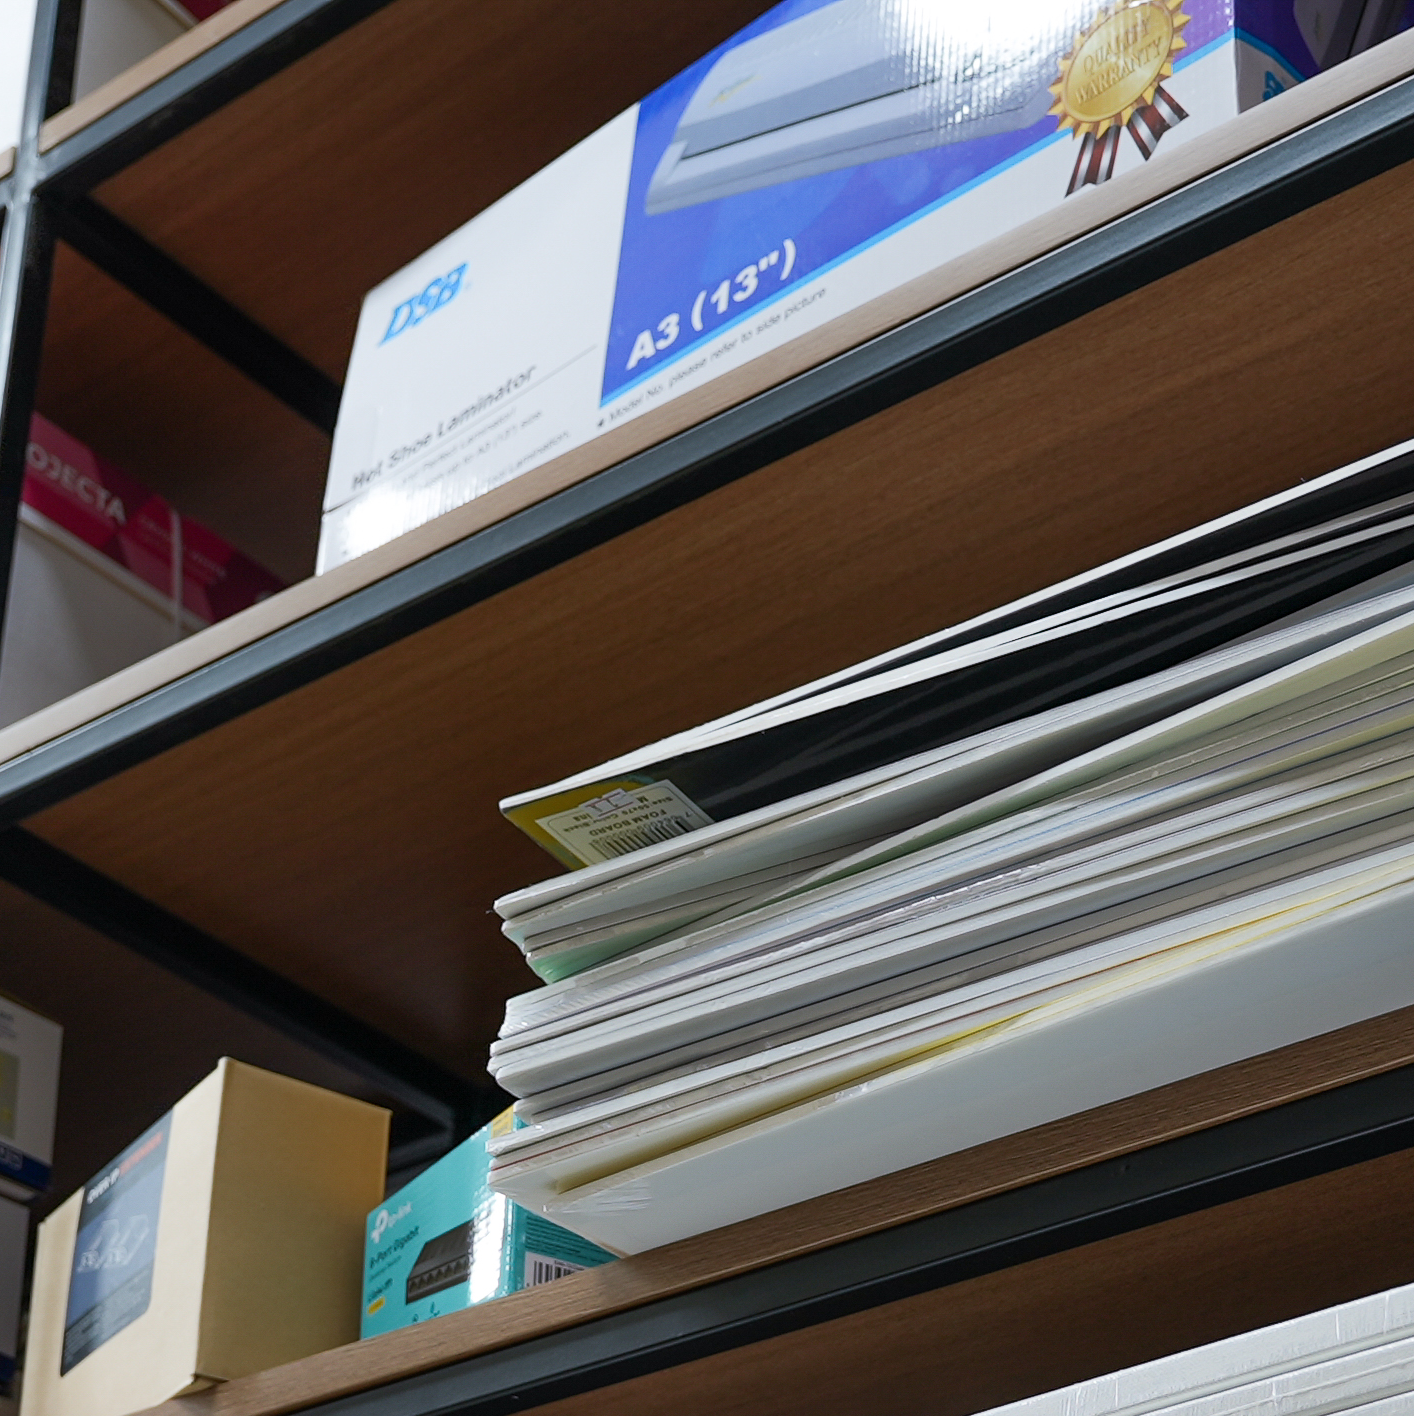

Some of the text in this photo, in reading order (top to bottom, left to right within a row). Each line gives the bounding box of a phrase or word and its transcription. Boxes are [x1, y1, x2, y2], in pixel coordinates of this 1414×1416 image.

[1074, 36, 1163, 104] WARRANTY
[625, 312, 680, 371] A3
[437, 364, 537, 438] Laminator
[588, 818, 632, 838] BOARD
